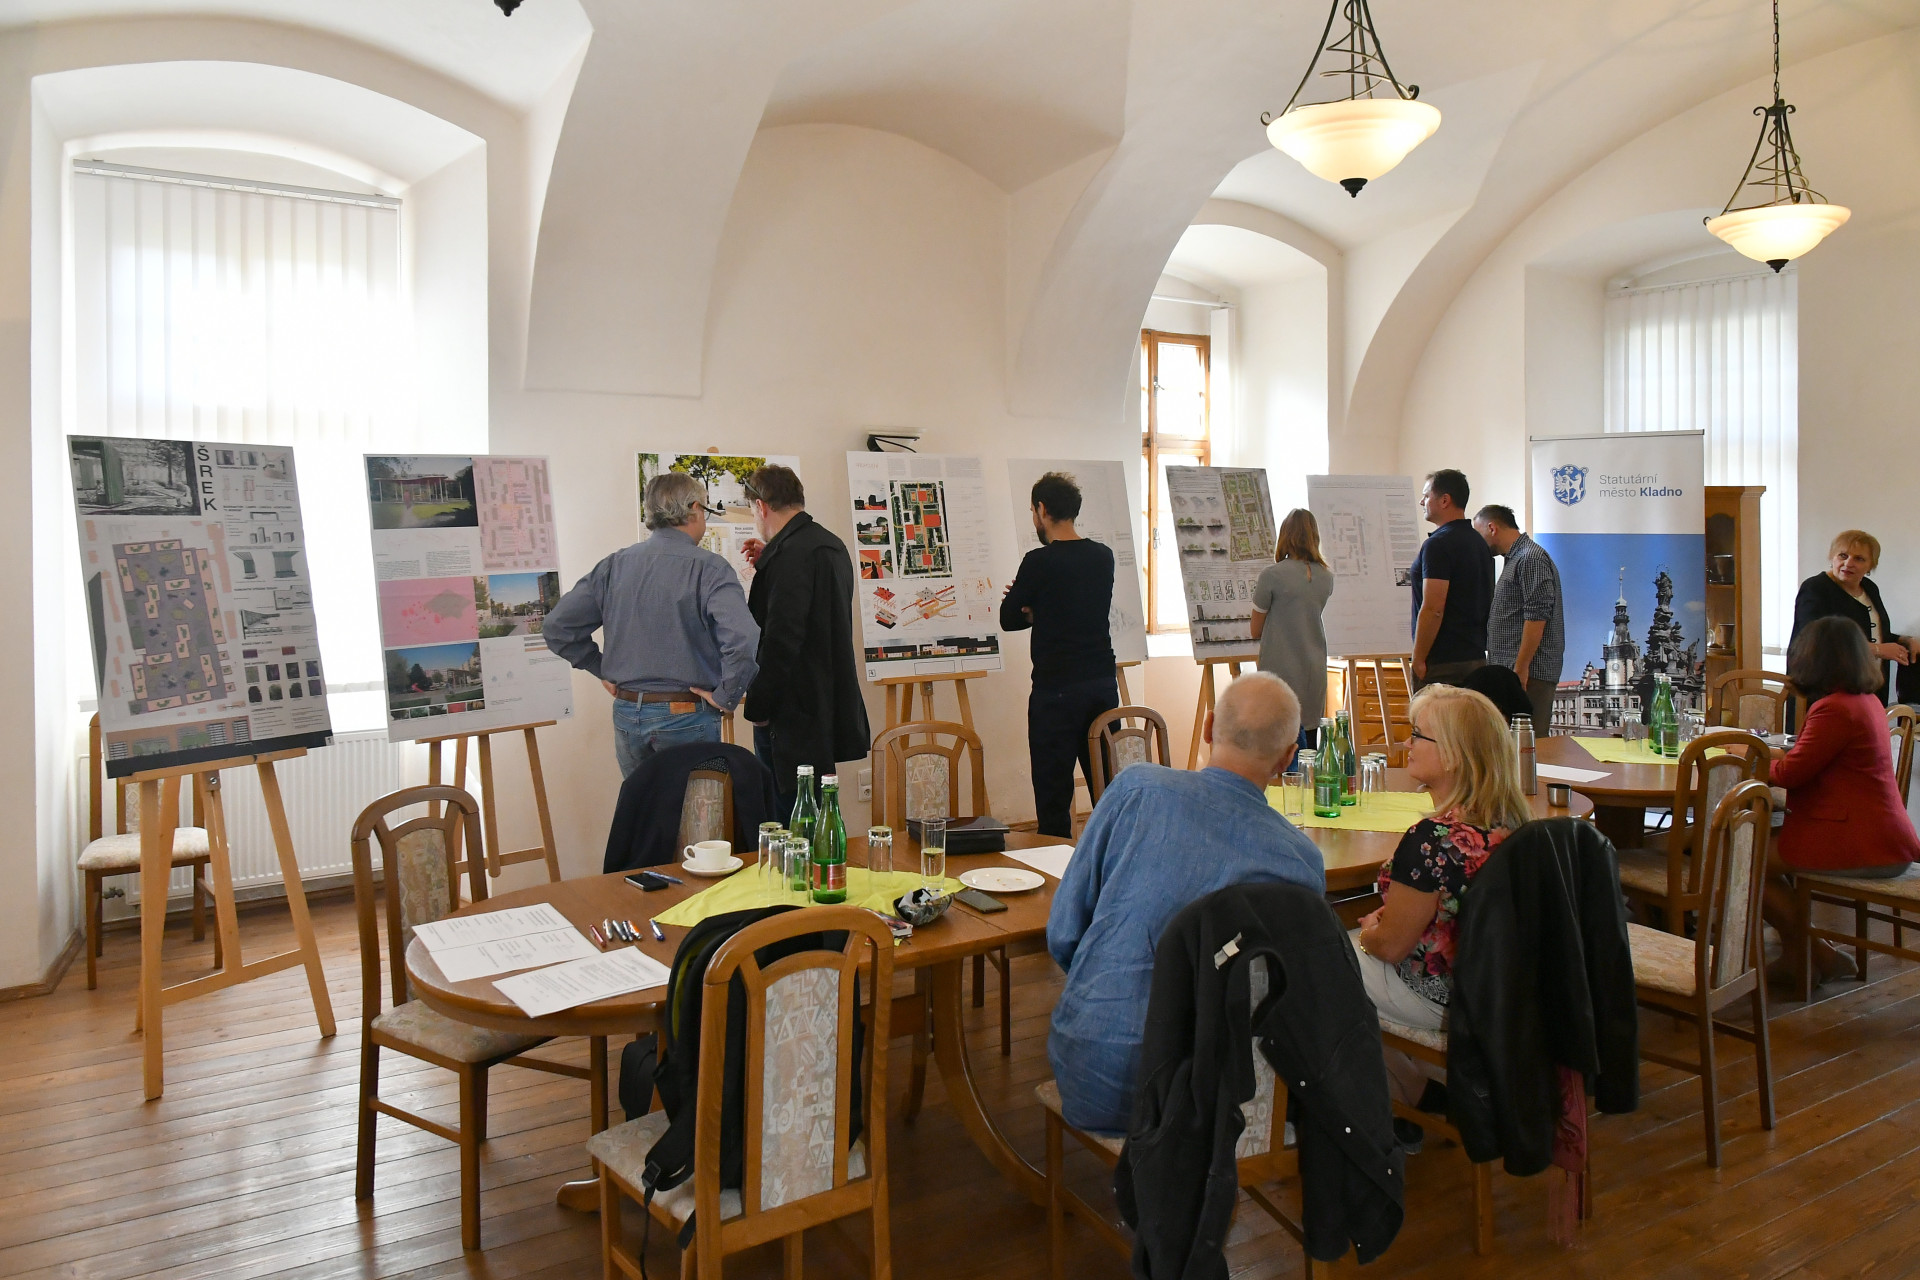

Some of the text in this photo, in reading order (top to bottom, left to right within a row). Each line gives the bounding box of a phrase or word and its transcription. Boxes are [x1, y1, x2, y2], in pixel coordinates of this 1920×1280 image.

[197, 445, 217, 510] ŠREK
[1599, 473, 1658, 485] Statutární
[1599, 486, 1683, 497] město Kladno
